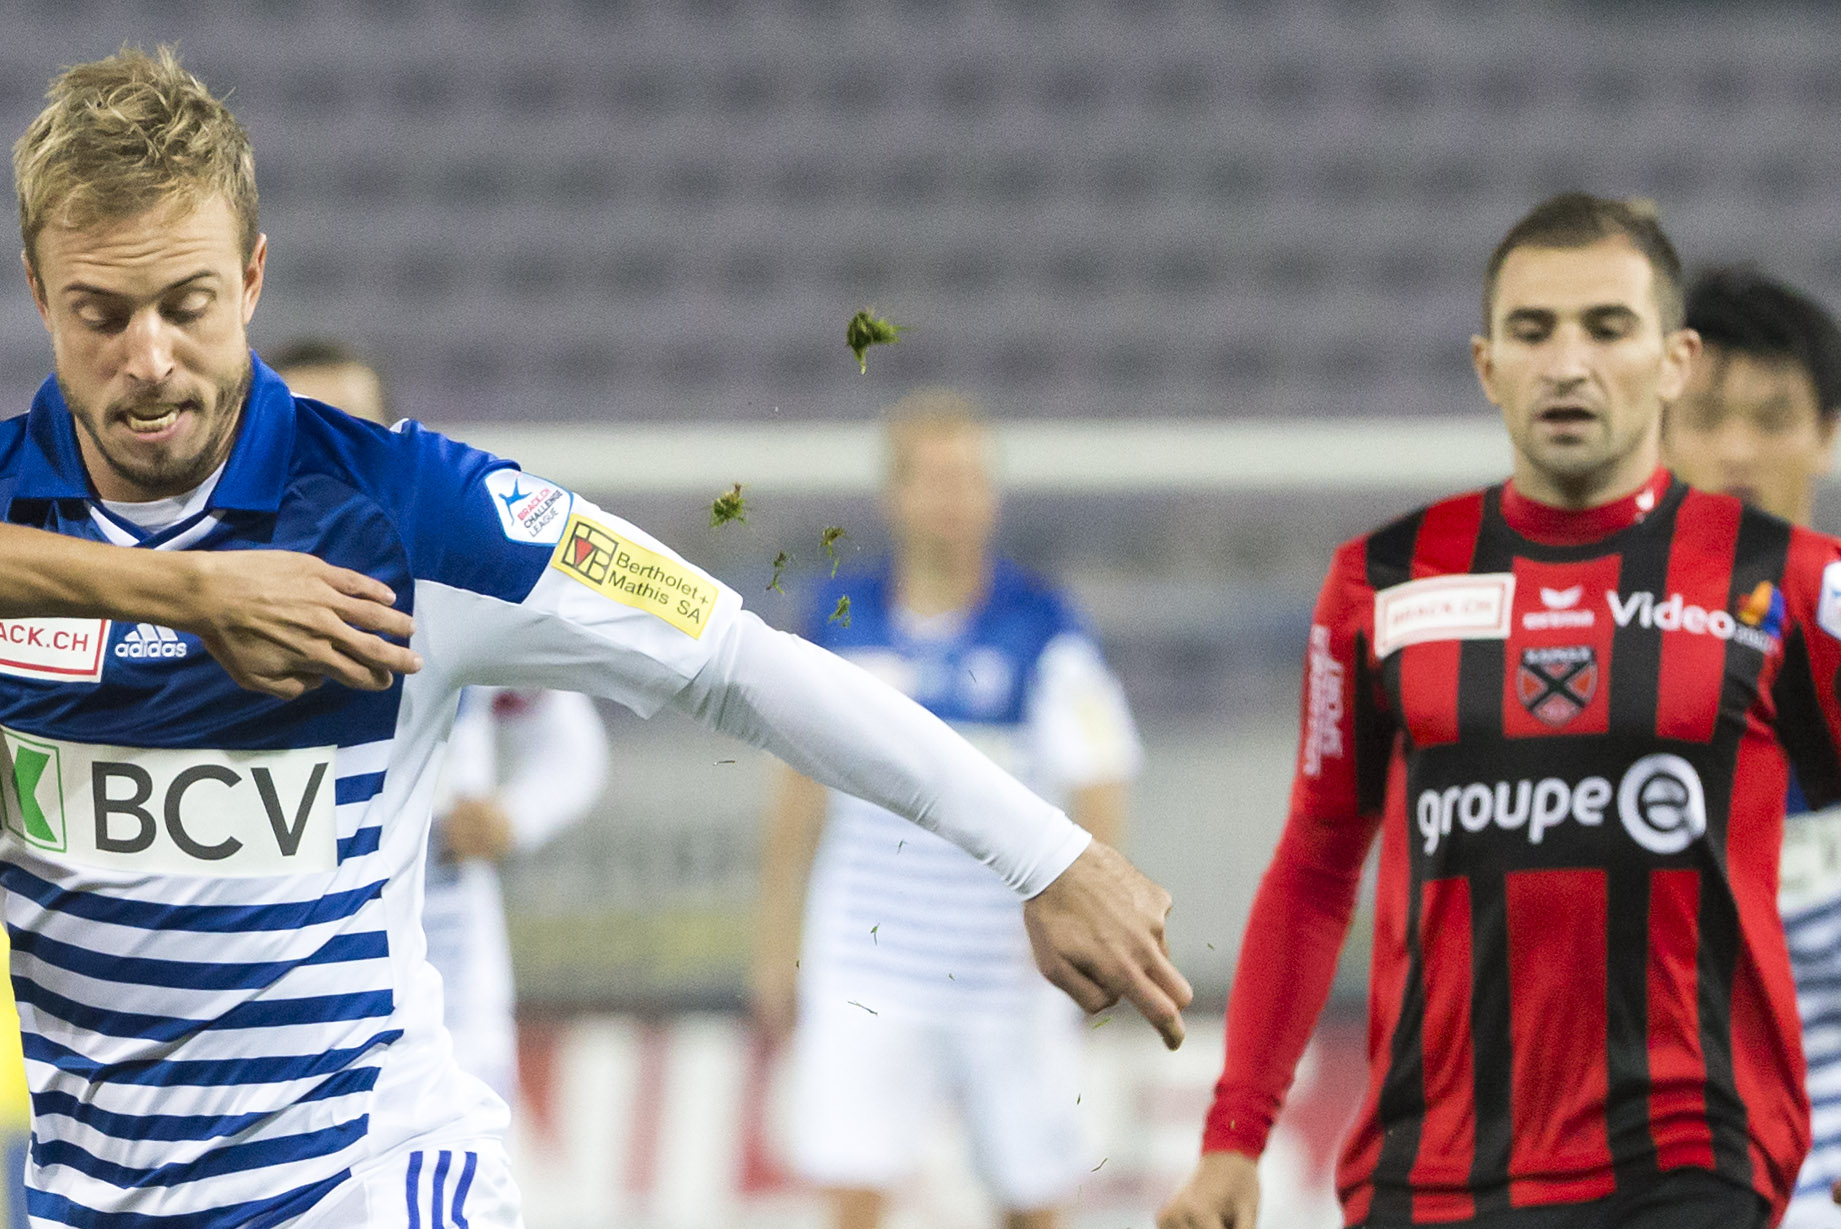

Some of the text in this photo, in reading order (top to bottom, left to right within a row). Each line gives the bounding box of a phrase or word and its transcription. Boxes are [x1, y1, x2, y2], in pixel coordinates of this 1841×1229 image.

[608, 569, 701, 625] Mathis SA
[1605, 590, 1737, 640] Video
[114, 640, 188, 659] adidas
[91, 761, 329, 861] BCV
[1416, 775, 1613, 856] groupe
